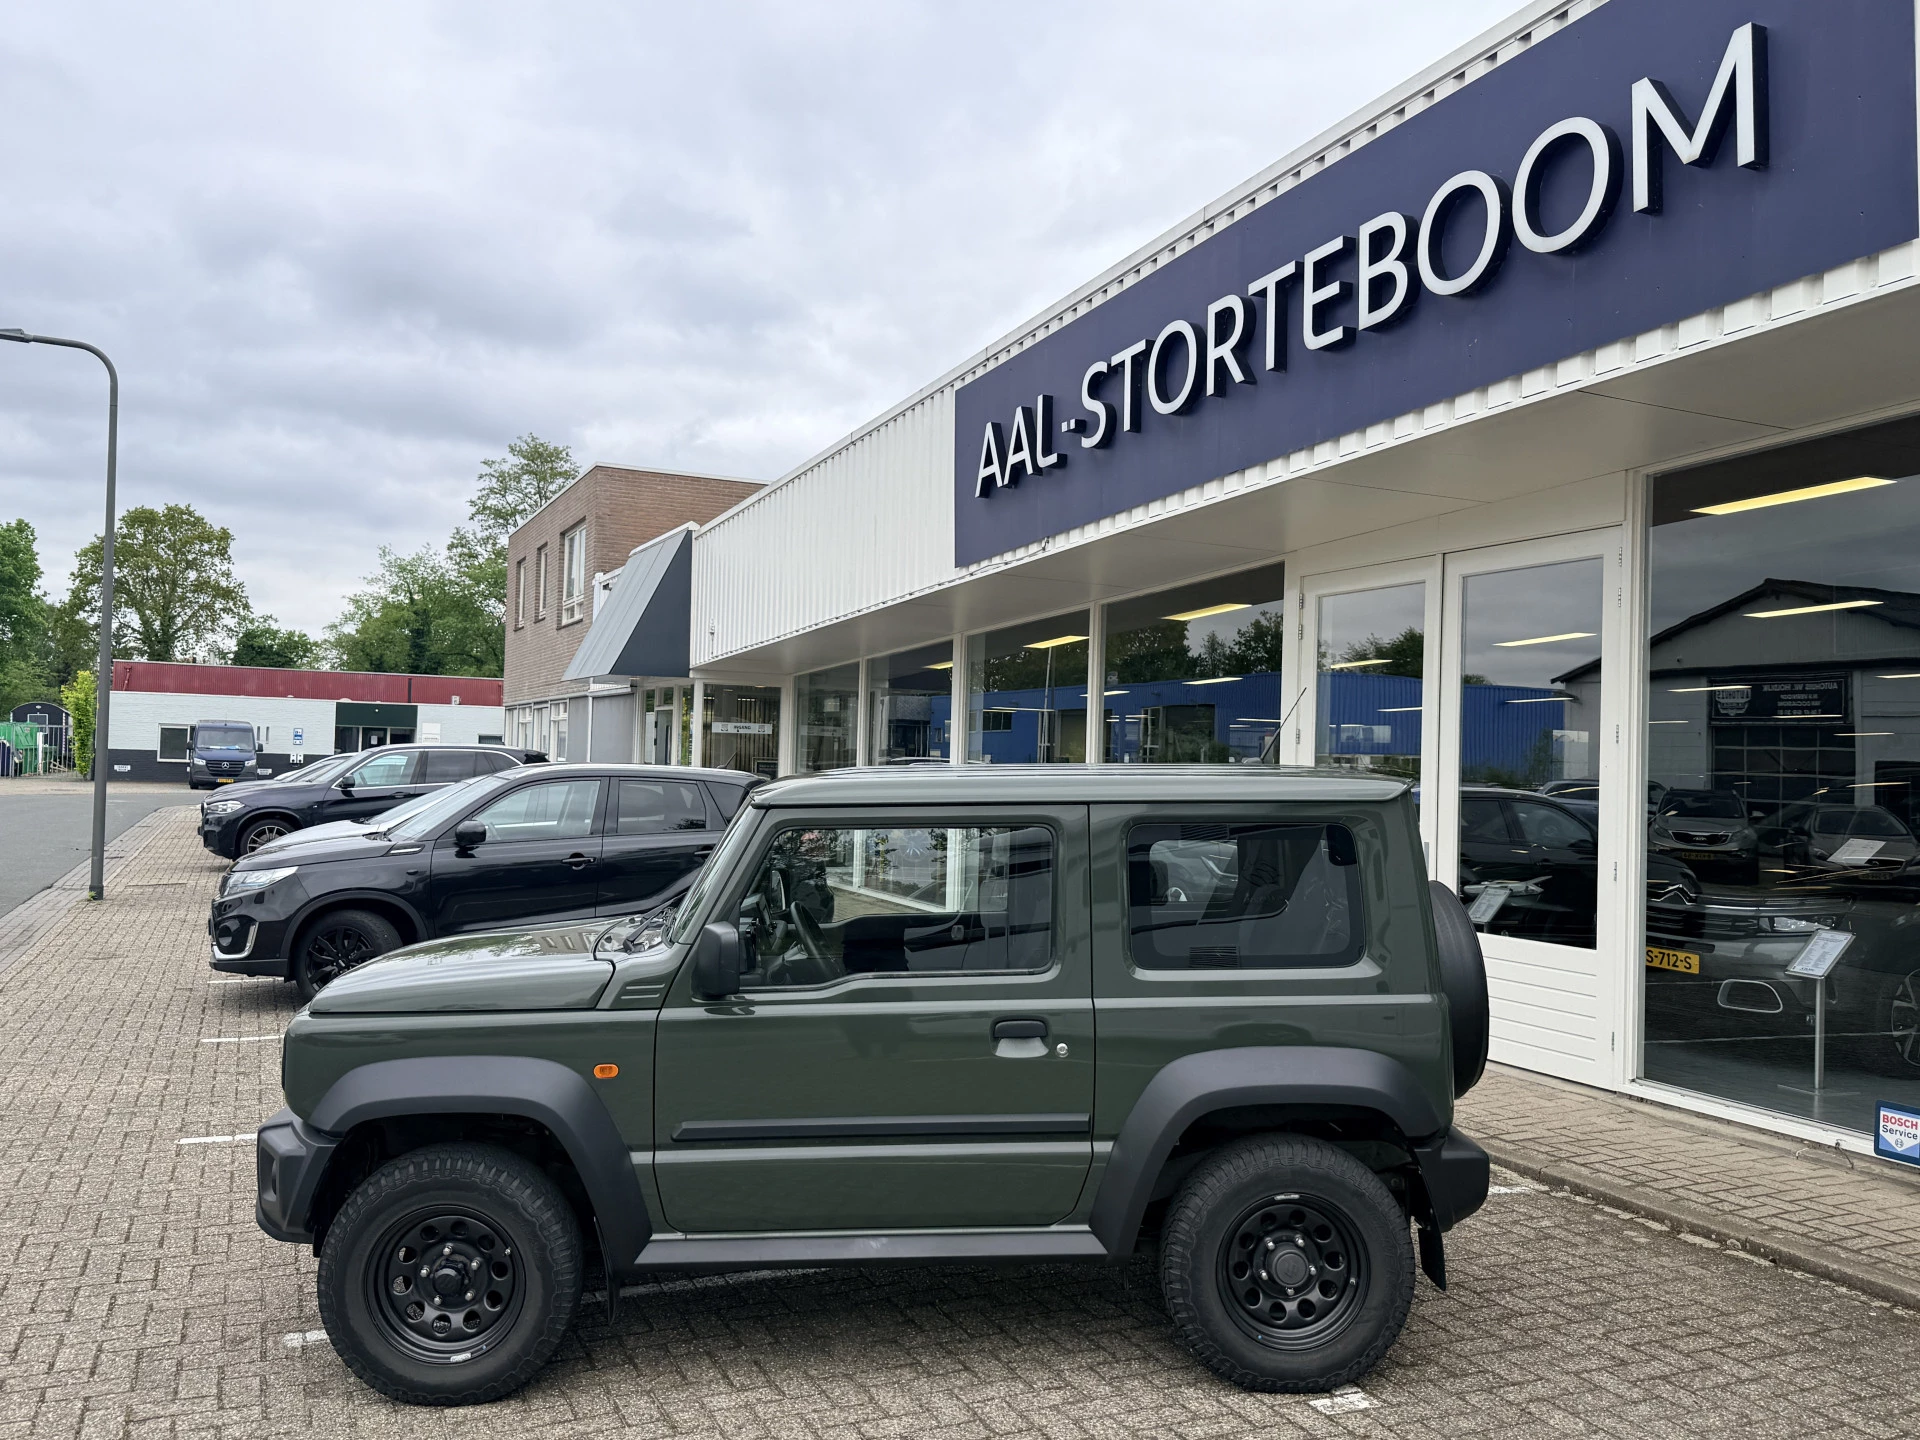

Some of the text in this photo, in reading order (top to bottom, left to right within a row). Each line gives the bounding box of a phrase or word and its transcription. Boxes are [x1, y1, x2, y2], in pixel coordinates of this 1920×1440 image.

[975, 21, 1762, 498] AAL-STORTEBOOM
[1882, 1114, 1918, 1130] BOSCH
[1881, 1124, 1918, 1140] Service
